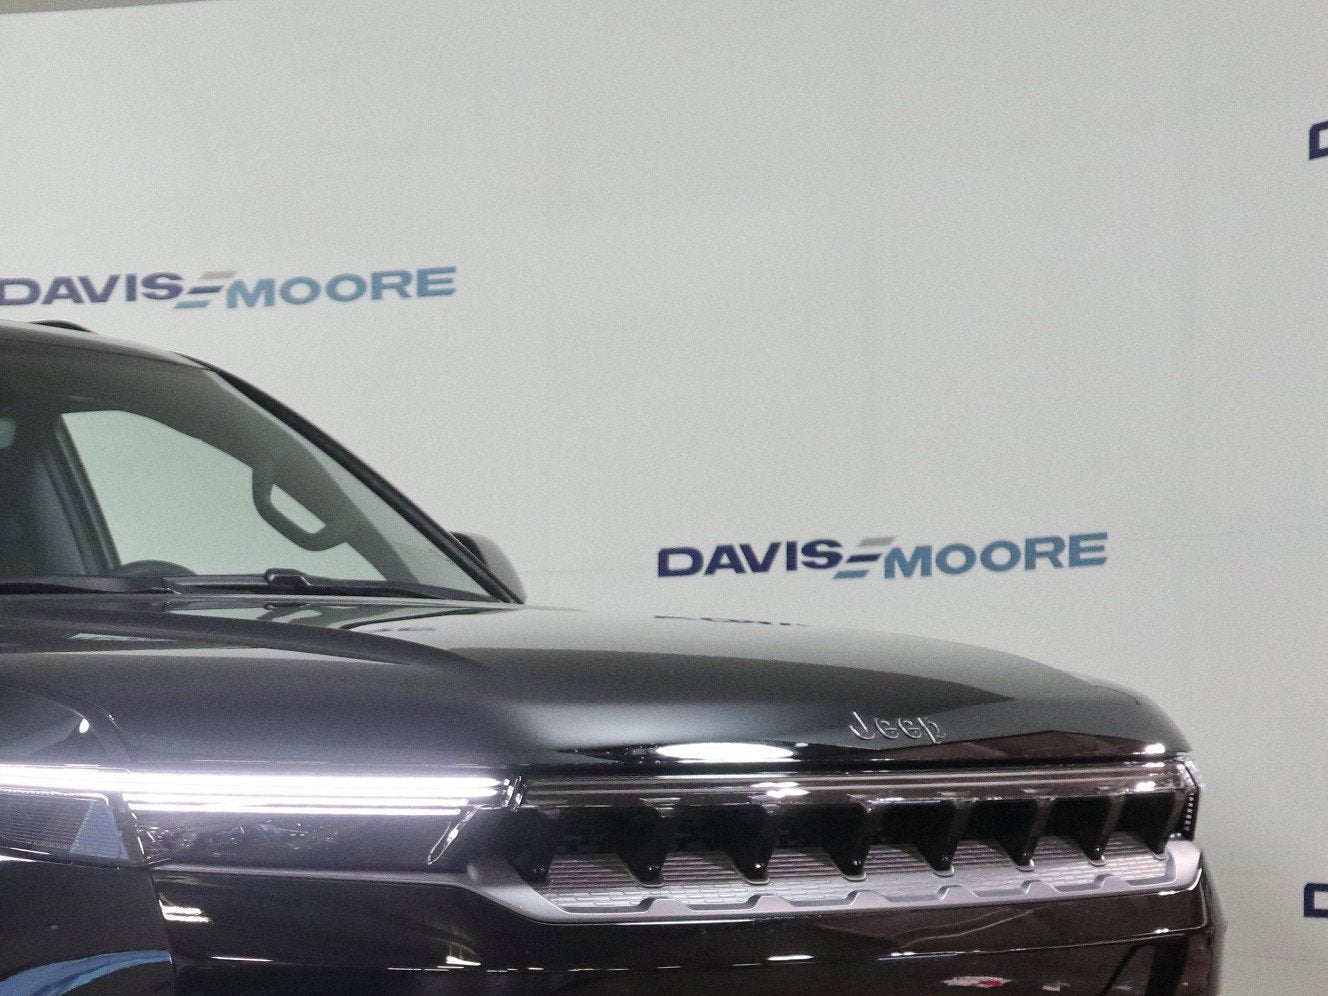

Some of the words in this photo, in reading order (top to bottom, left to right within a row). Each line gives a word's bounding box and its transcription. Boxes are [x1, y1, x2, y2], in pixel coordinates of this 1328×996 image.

[226, 266, 456, 309] MOORE
[657, 538, 843, 577] DAVIS
[884, 532, 1108, 579] MOORE
[849, 711, 947, 744] Jeep
